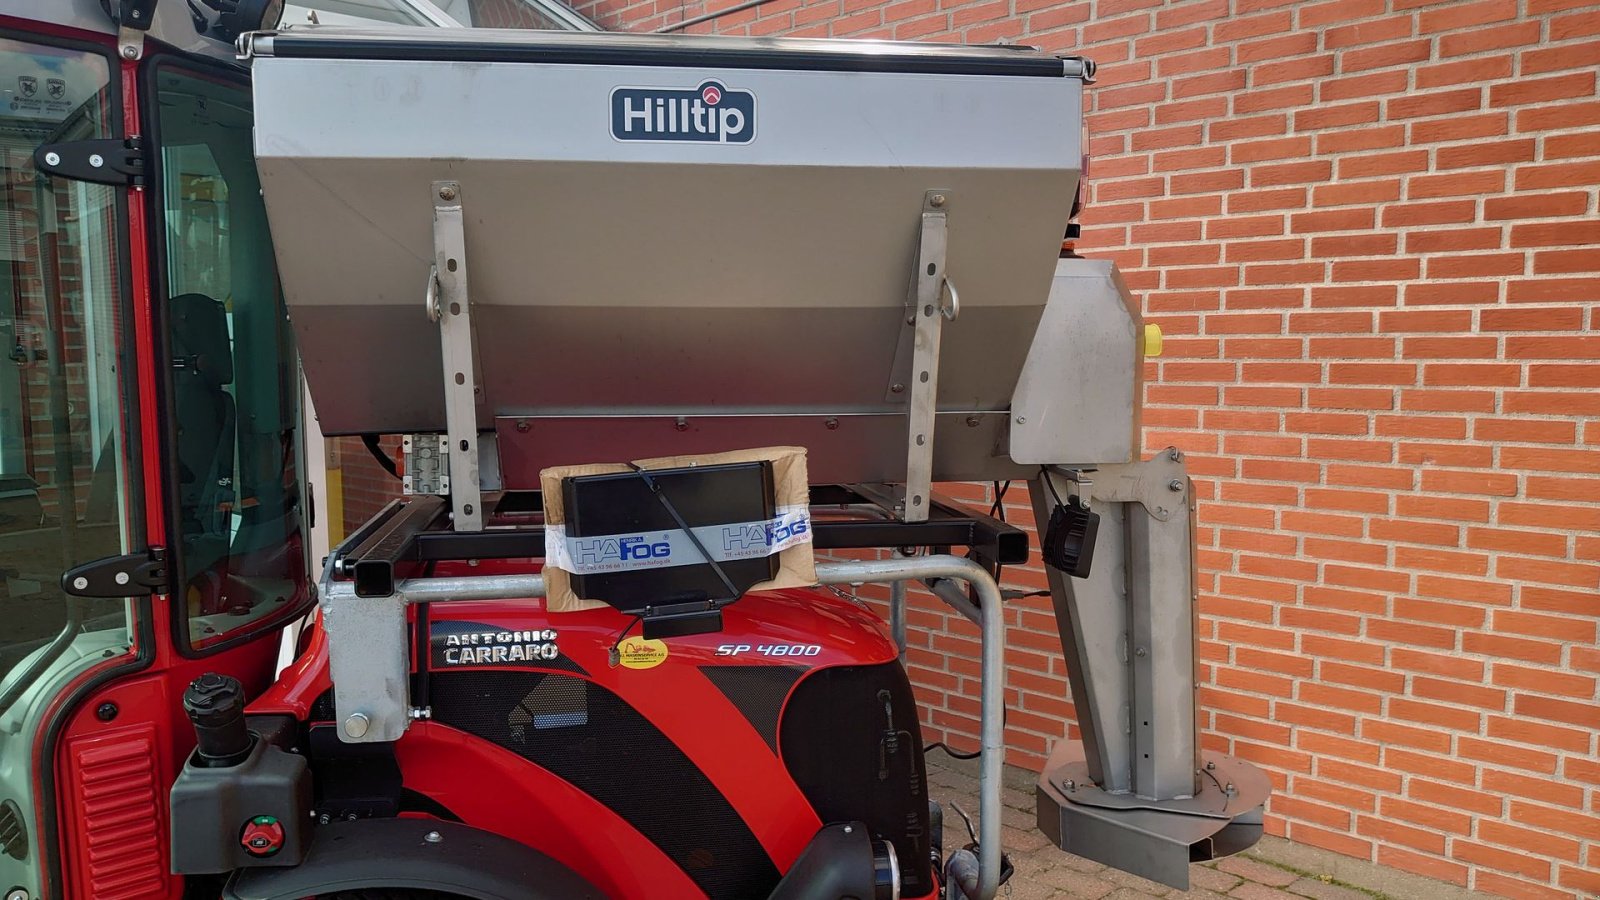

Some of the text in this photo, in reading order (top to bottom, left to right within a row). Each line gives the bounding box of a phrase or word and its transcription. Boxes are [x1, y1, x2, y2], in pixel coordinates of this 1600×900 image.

[624, 86, 745, 143] Hilltip
[444, 629, 559, 647] ANTONIO
[443, 643, 560, 665] CARRARO
[714, 644, 822, 656] SP 4800
